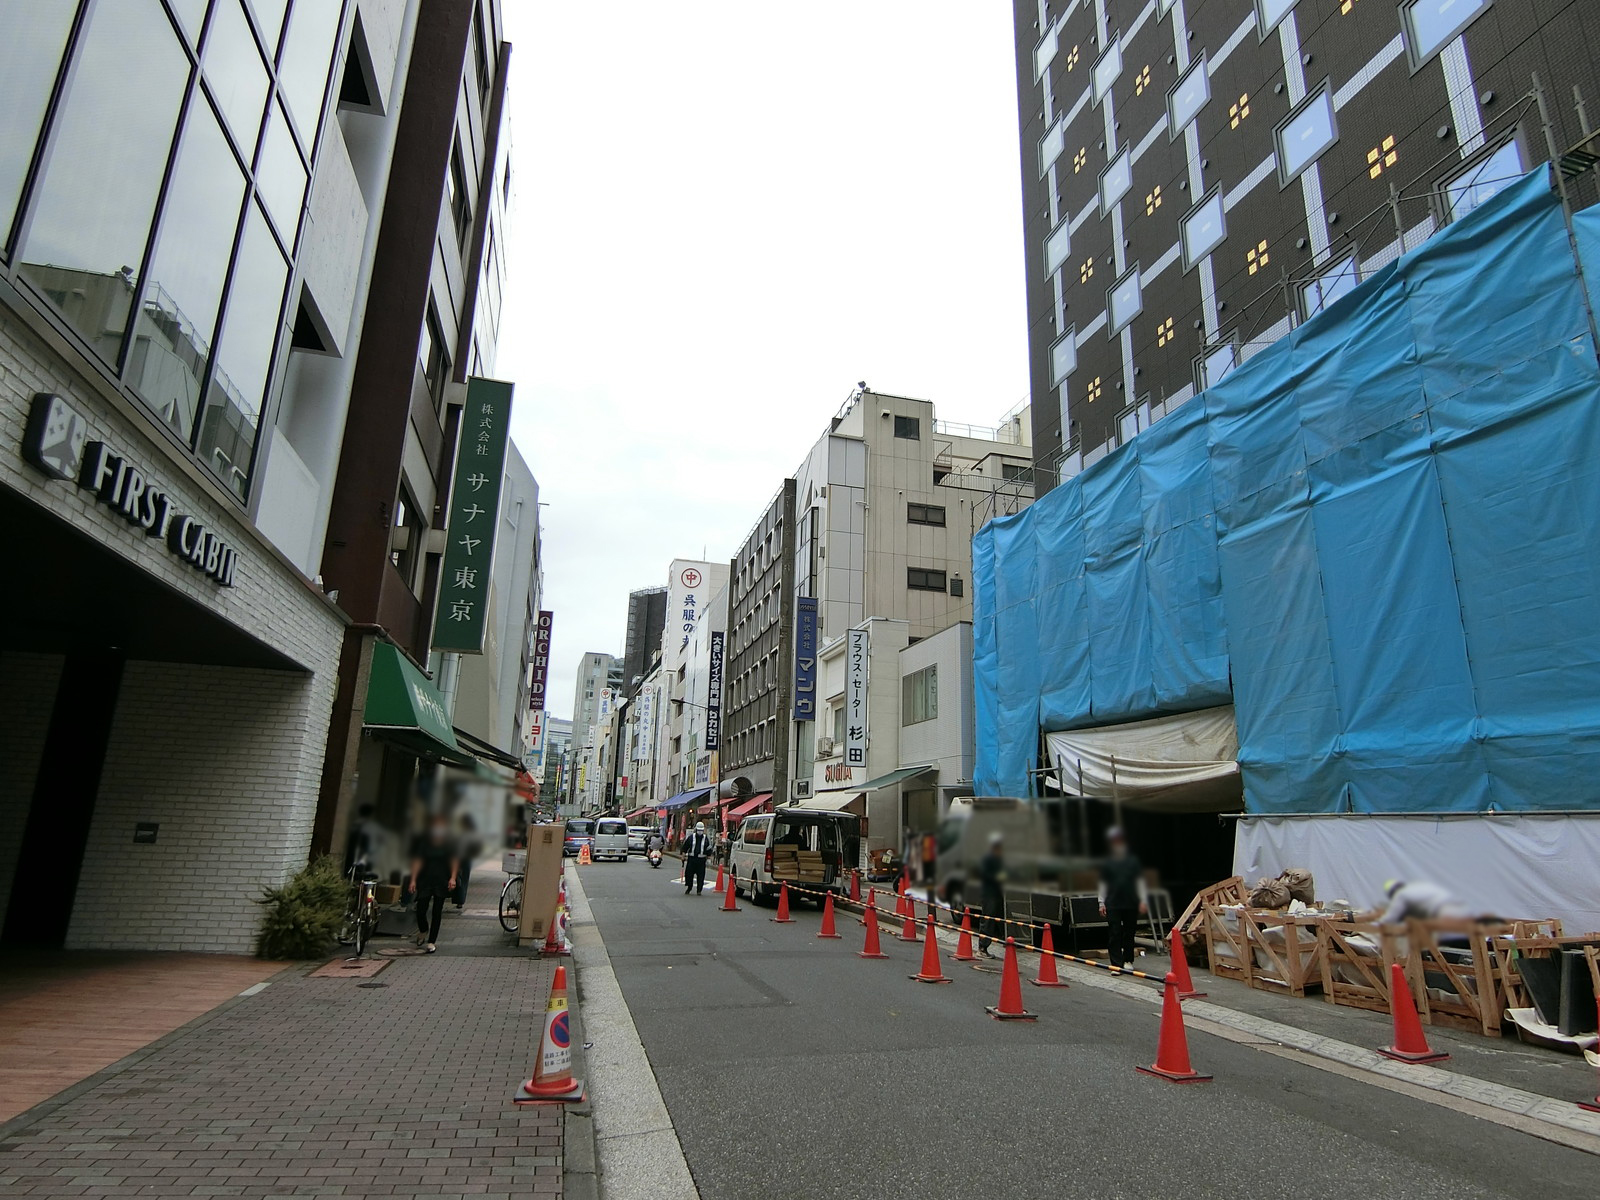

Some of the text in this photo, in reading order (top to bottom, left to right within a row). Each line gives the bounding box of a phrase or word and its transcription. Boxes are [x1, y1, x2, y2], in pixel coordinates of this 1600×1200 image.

[81, 441, 240, 588] FIRST CABIN
[448, 403, 494, 623] 株式会社 サナヤ東京
[532, 616, 550, 694] ORCHID
[848, 633, 863, 763] ブラウス・セーター 杉田
